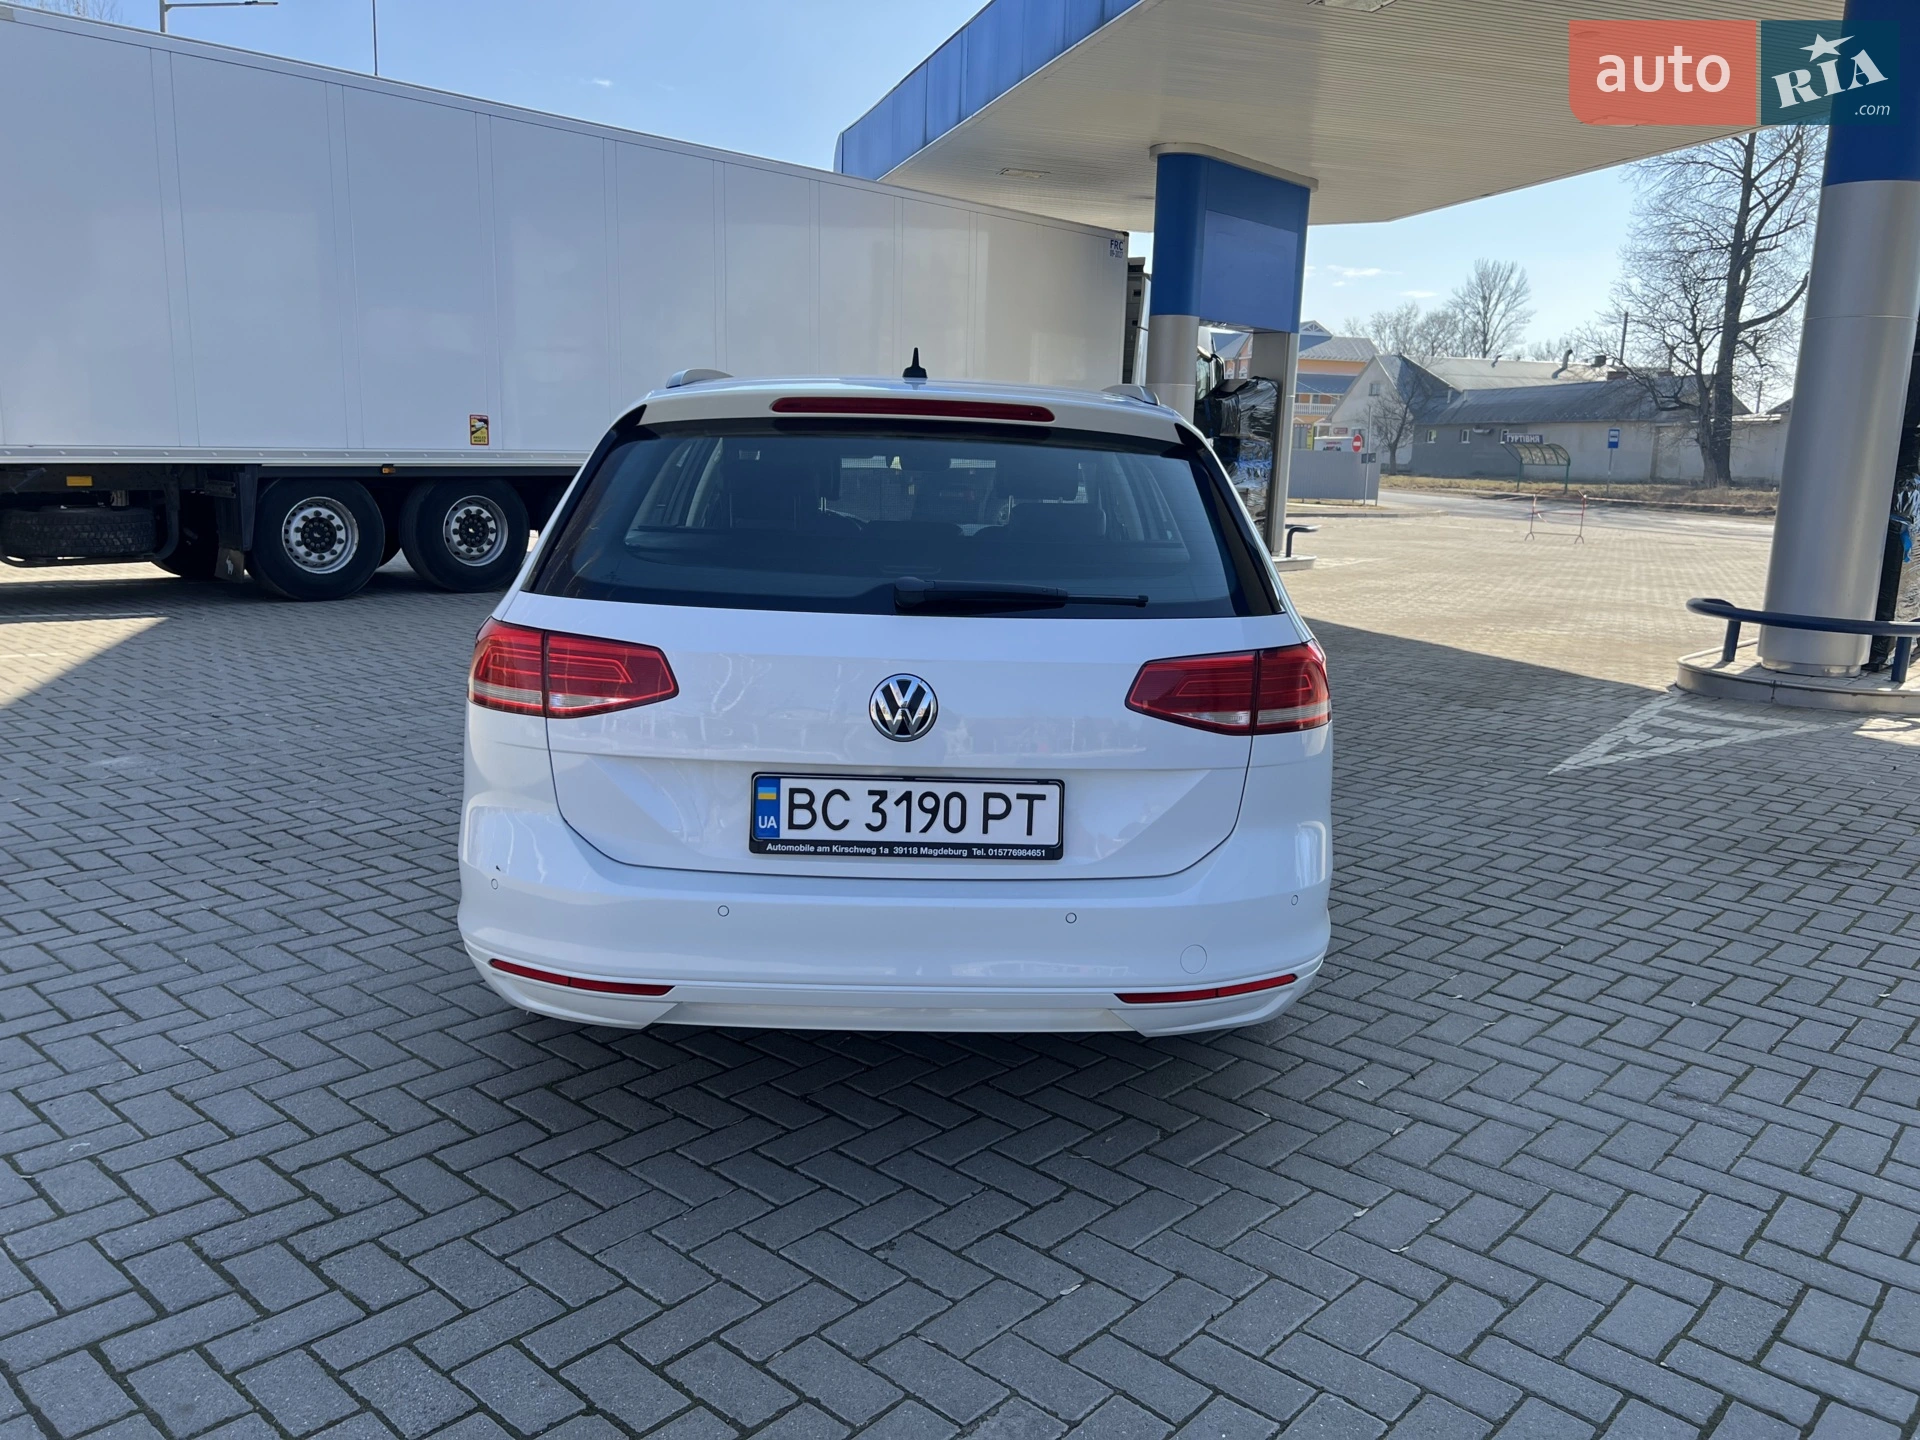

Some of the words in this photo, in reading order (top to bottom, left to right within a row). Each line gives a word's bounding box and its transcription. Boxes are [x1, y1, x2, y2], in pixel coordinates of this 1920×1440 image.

[1110, 240, 1123, 250] FRC
[788, 787, 850, 831] BC
[865, 789, 967, 834] 3190
[982, 792, 1047, 836] PT
[758, 815, 778, 829] UA
[766, 842, 815, 852] Automobile
[816, 845, 830, 853] am
[832, 844, 877, 855] Kirschweg
[879, 846, 889, 854] 1a
[893, 846, 918, 855] 39118
[920, 847, 968, 857] Magdeburg
[972, 847, 987, 856] Tel.
[988, 848, 1046, 857] 015776984651
